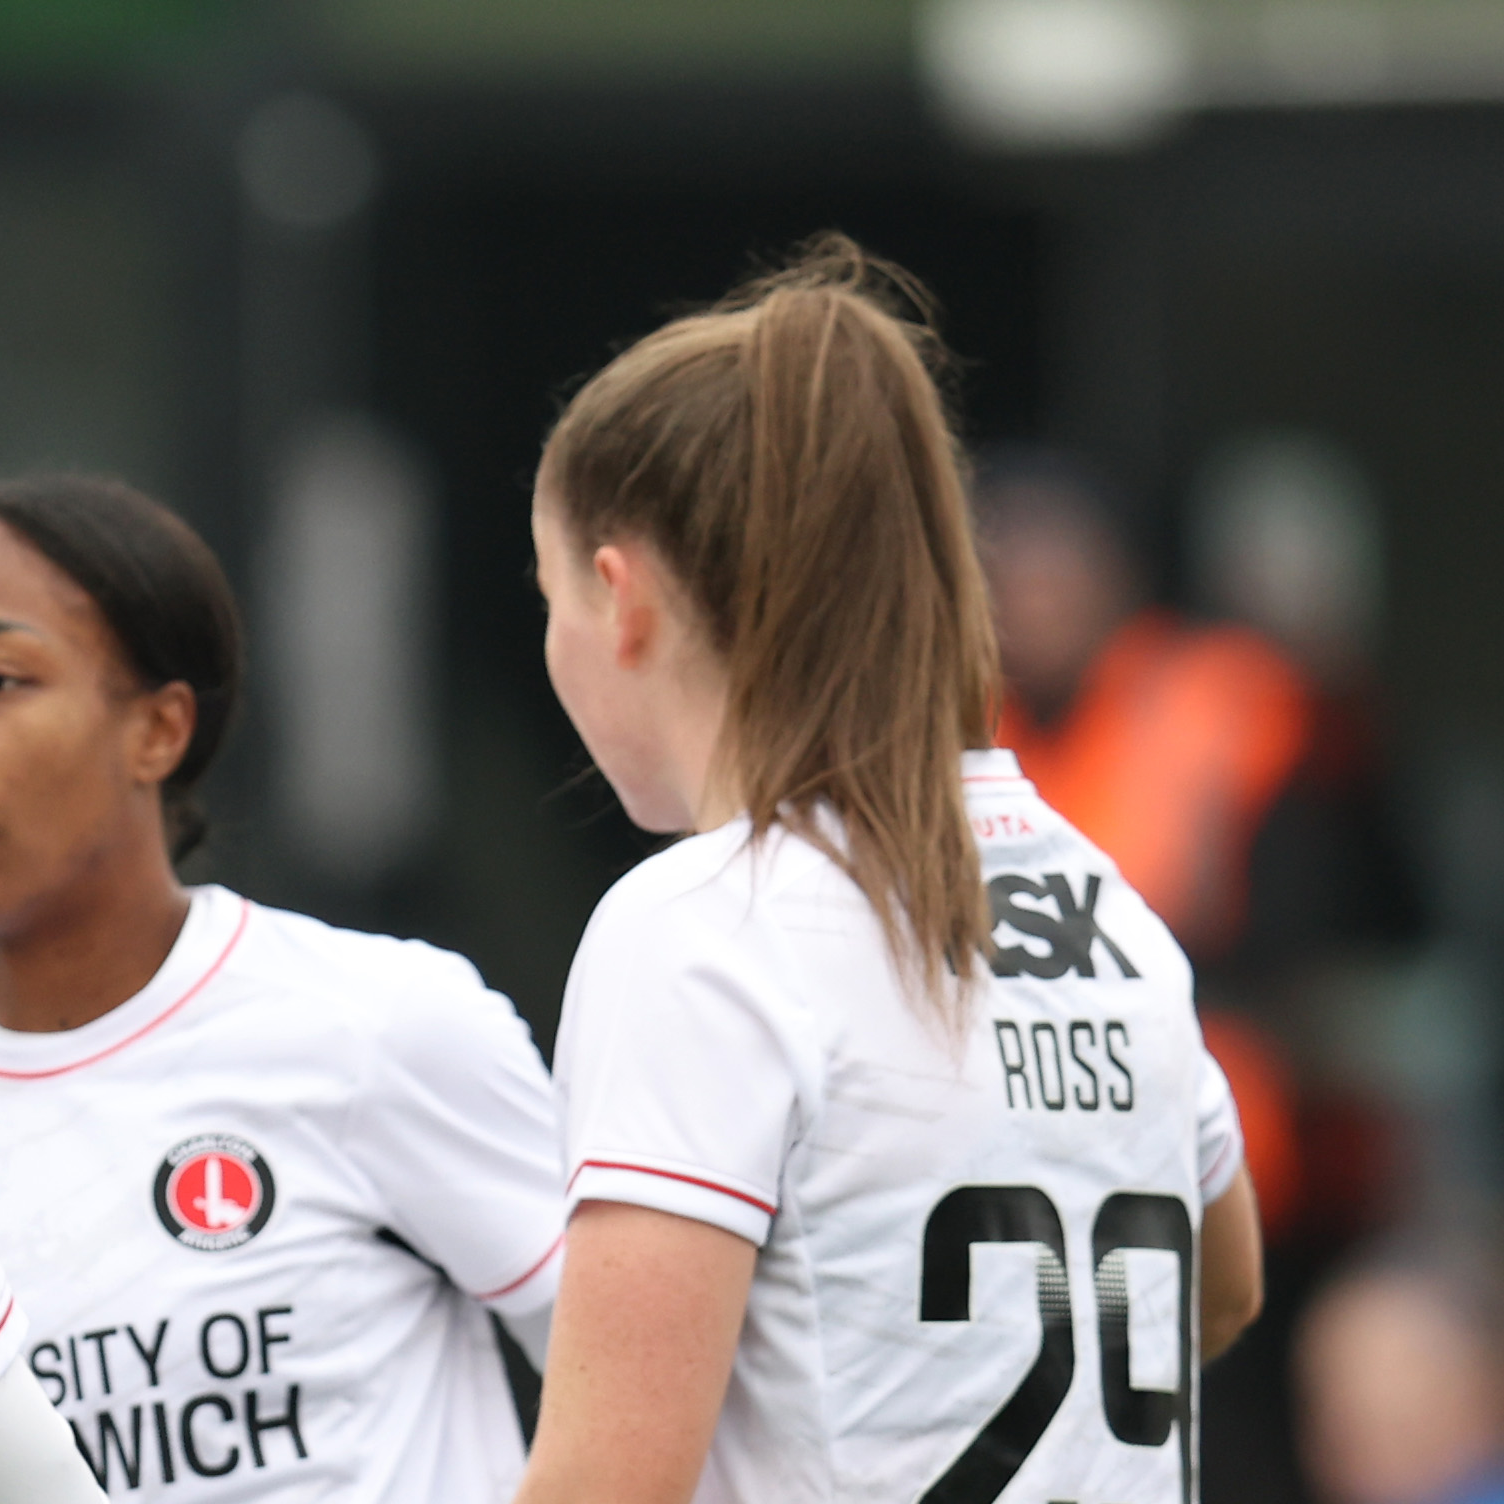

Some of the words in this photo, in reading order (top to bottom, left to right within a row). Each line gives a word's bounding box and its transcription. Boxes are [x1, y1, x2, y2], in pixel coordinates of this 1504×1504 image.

[994, 1019, 1134, 1111] ROSS
[30, 1318, 169, 1408] SITY
[199, 1306, 293, 1380] OF
[66, 1383, 309, 1495] WICH
